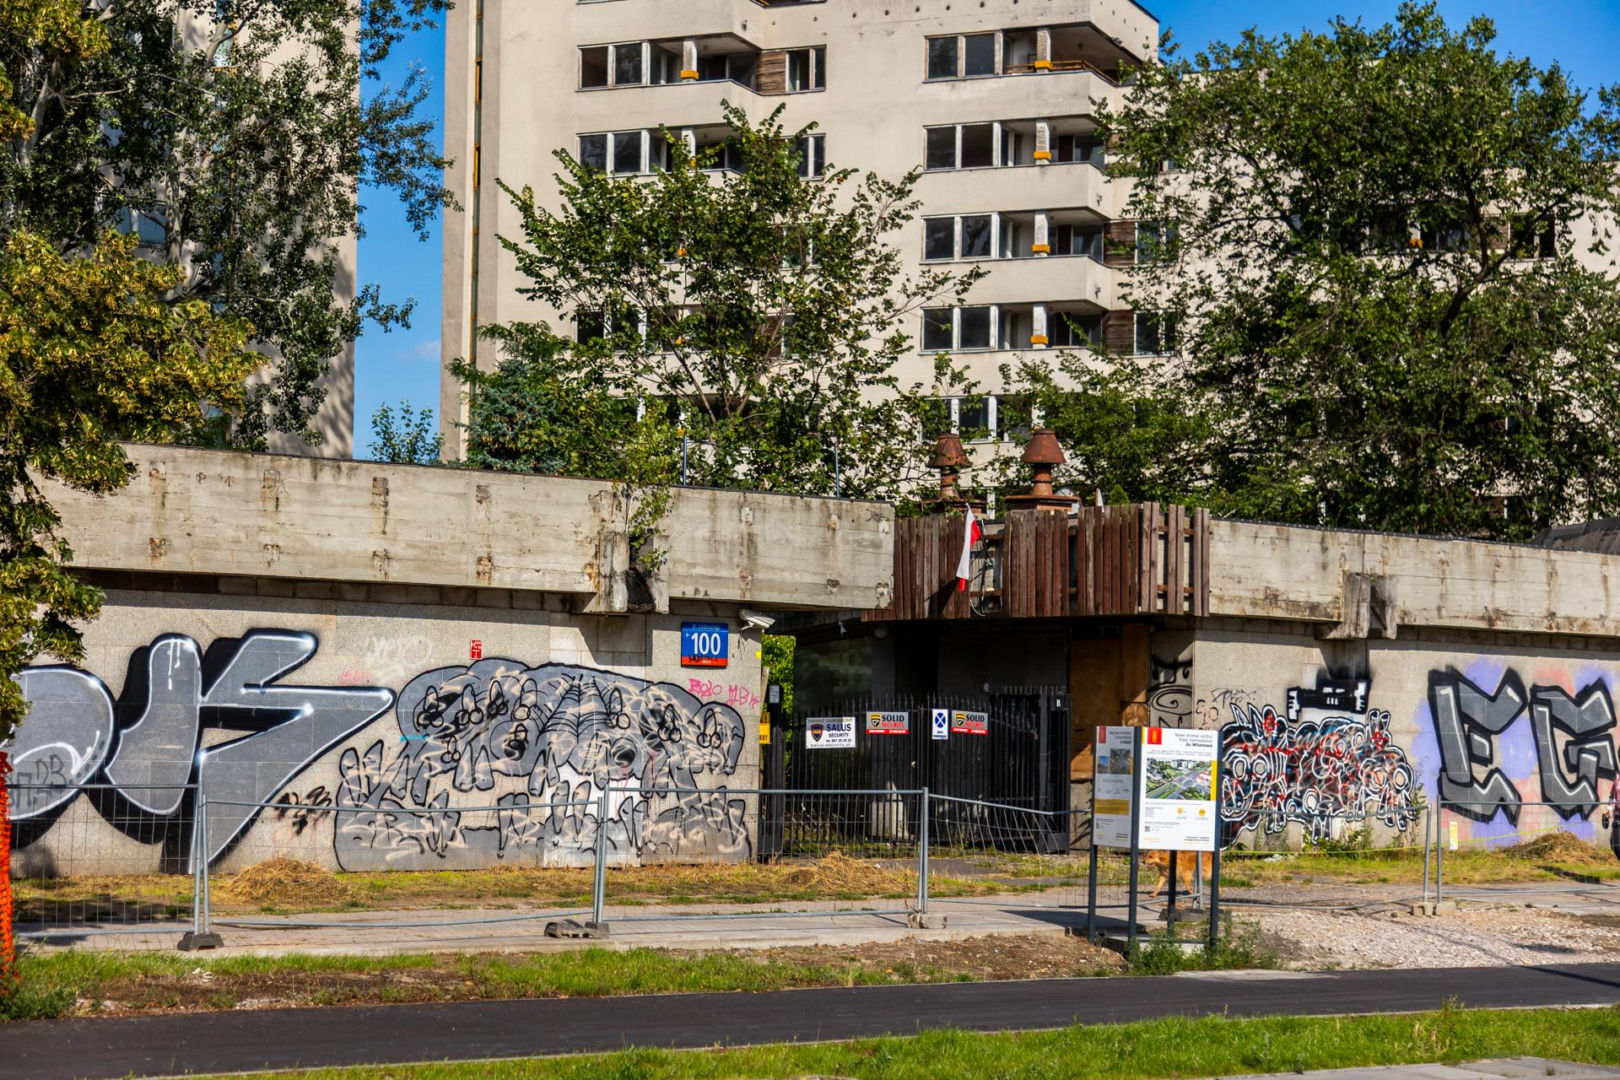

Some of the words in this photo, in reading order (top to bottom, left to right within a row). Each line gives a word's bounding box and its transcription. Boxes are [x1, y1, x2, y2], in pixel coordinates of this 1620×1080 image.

[691, 632, 721, 655] 100
[881, 714, 905, 722] SOLID
[966, 714, 985, 722] SOLID
[826, 723, 852, 732] SALUS
